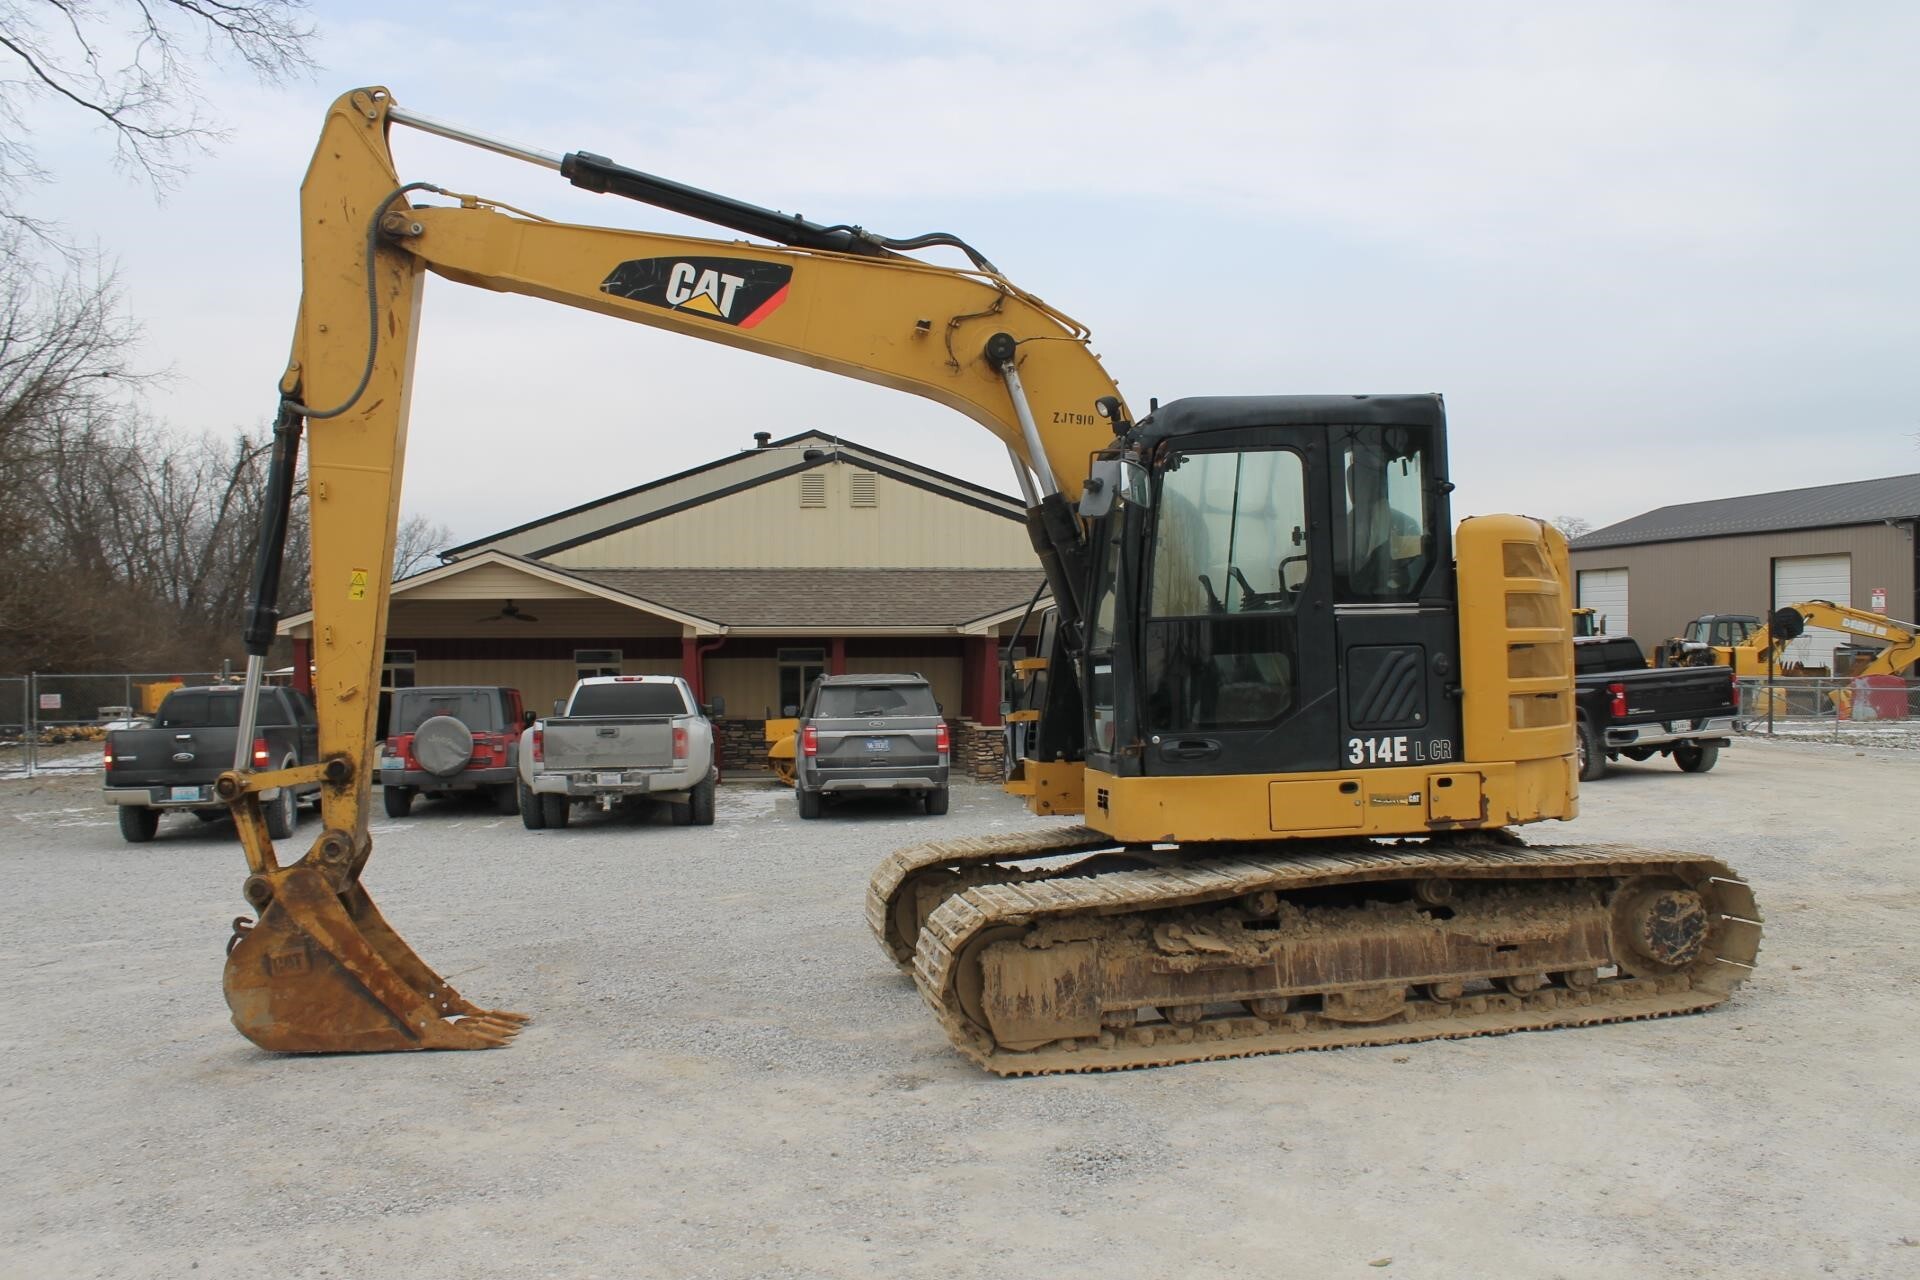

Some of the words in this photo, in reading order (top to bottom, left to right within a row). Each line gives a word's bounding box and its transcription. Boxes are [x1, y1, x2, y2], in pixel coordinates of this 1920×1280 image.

[665, 262, 745, 318] CAT
[1348, 736, 1408, 764] 314E
[1415, 741, 1426, 761] L
[1429, 739, 1452, 760] CR
